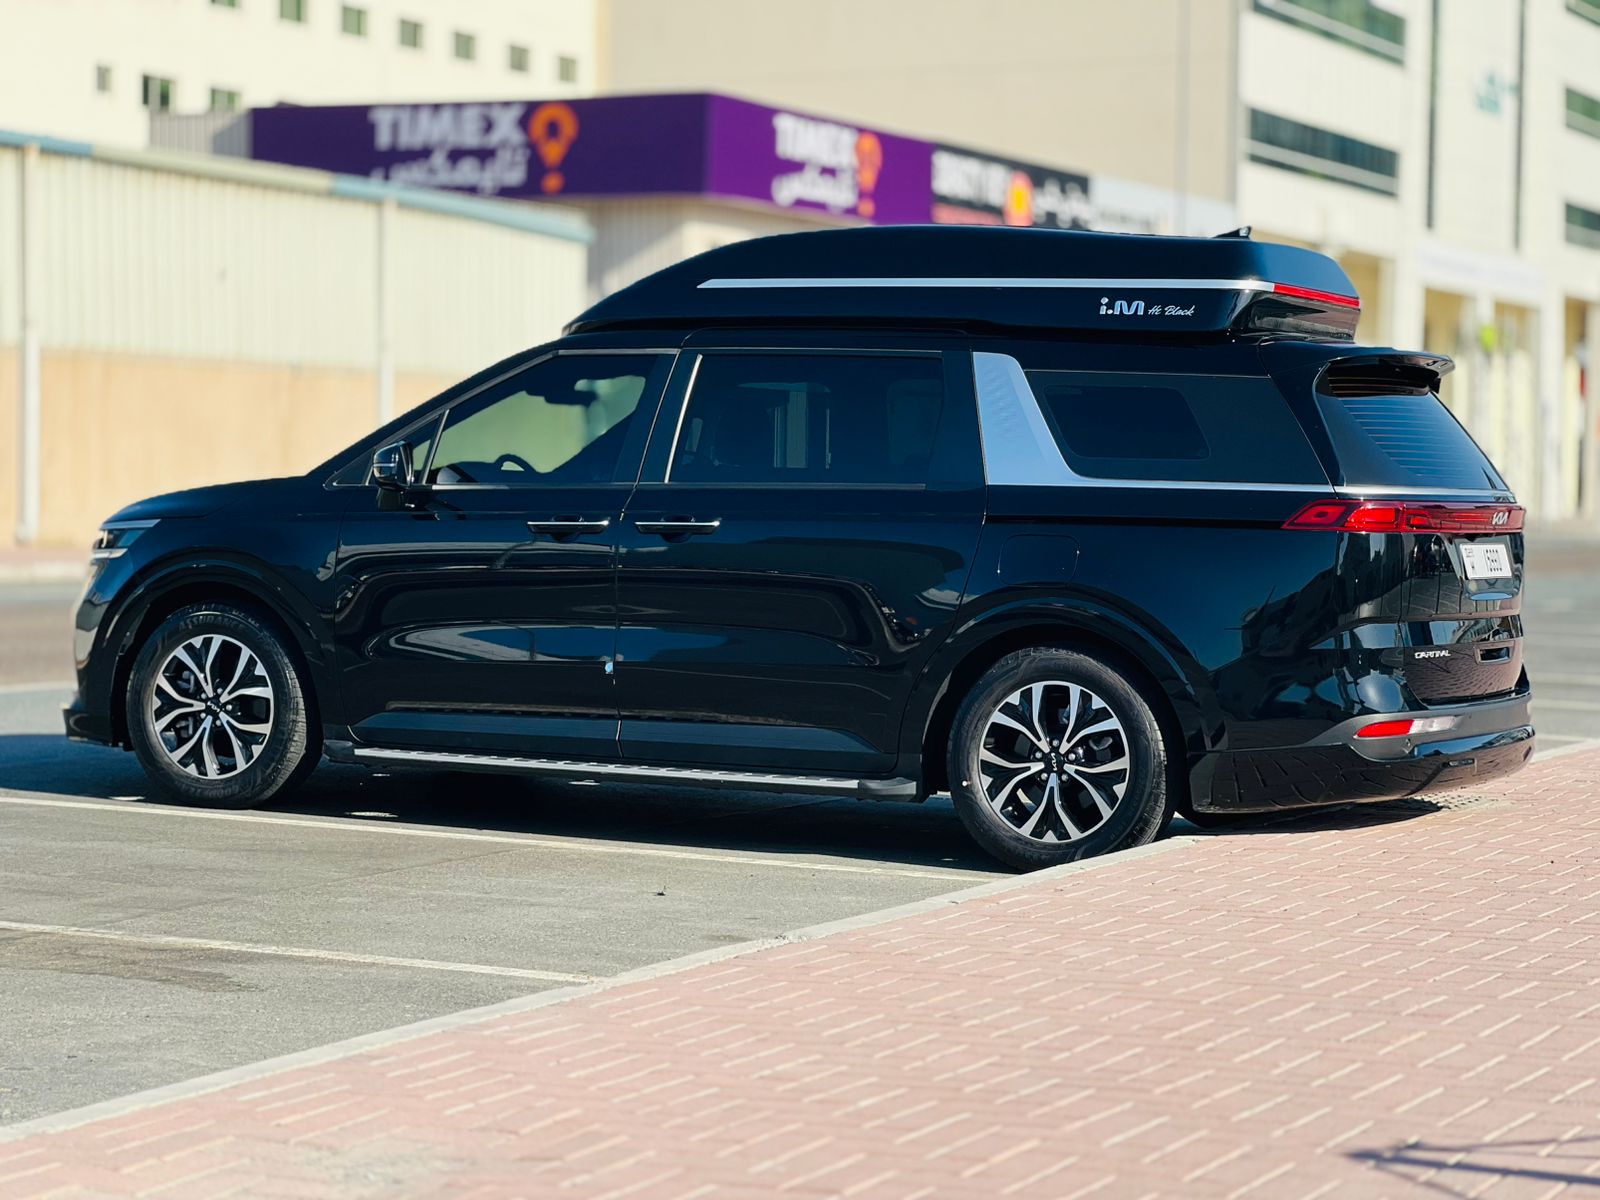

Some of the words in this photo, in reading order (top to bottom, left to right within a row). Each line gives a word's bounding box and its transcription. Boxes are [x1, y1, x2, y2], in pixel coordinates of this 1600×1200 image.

[368, 102, 527, 152] TIMEX
[772, 111, 859, 168] TIMEX
[1164, 304, 1196, 317] Black
[1491, 511, 1510, 525] KIA
